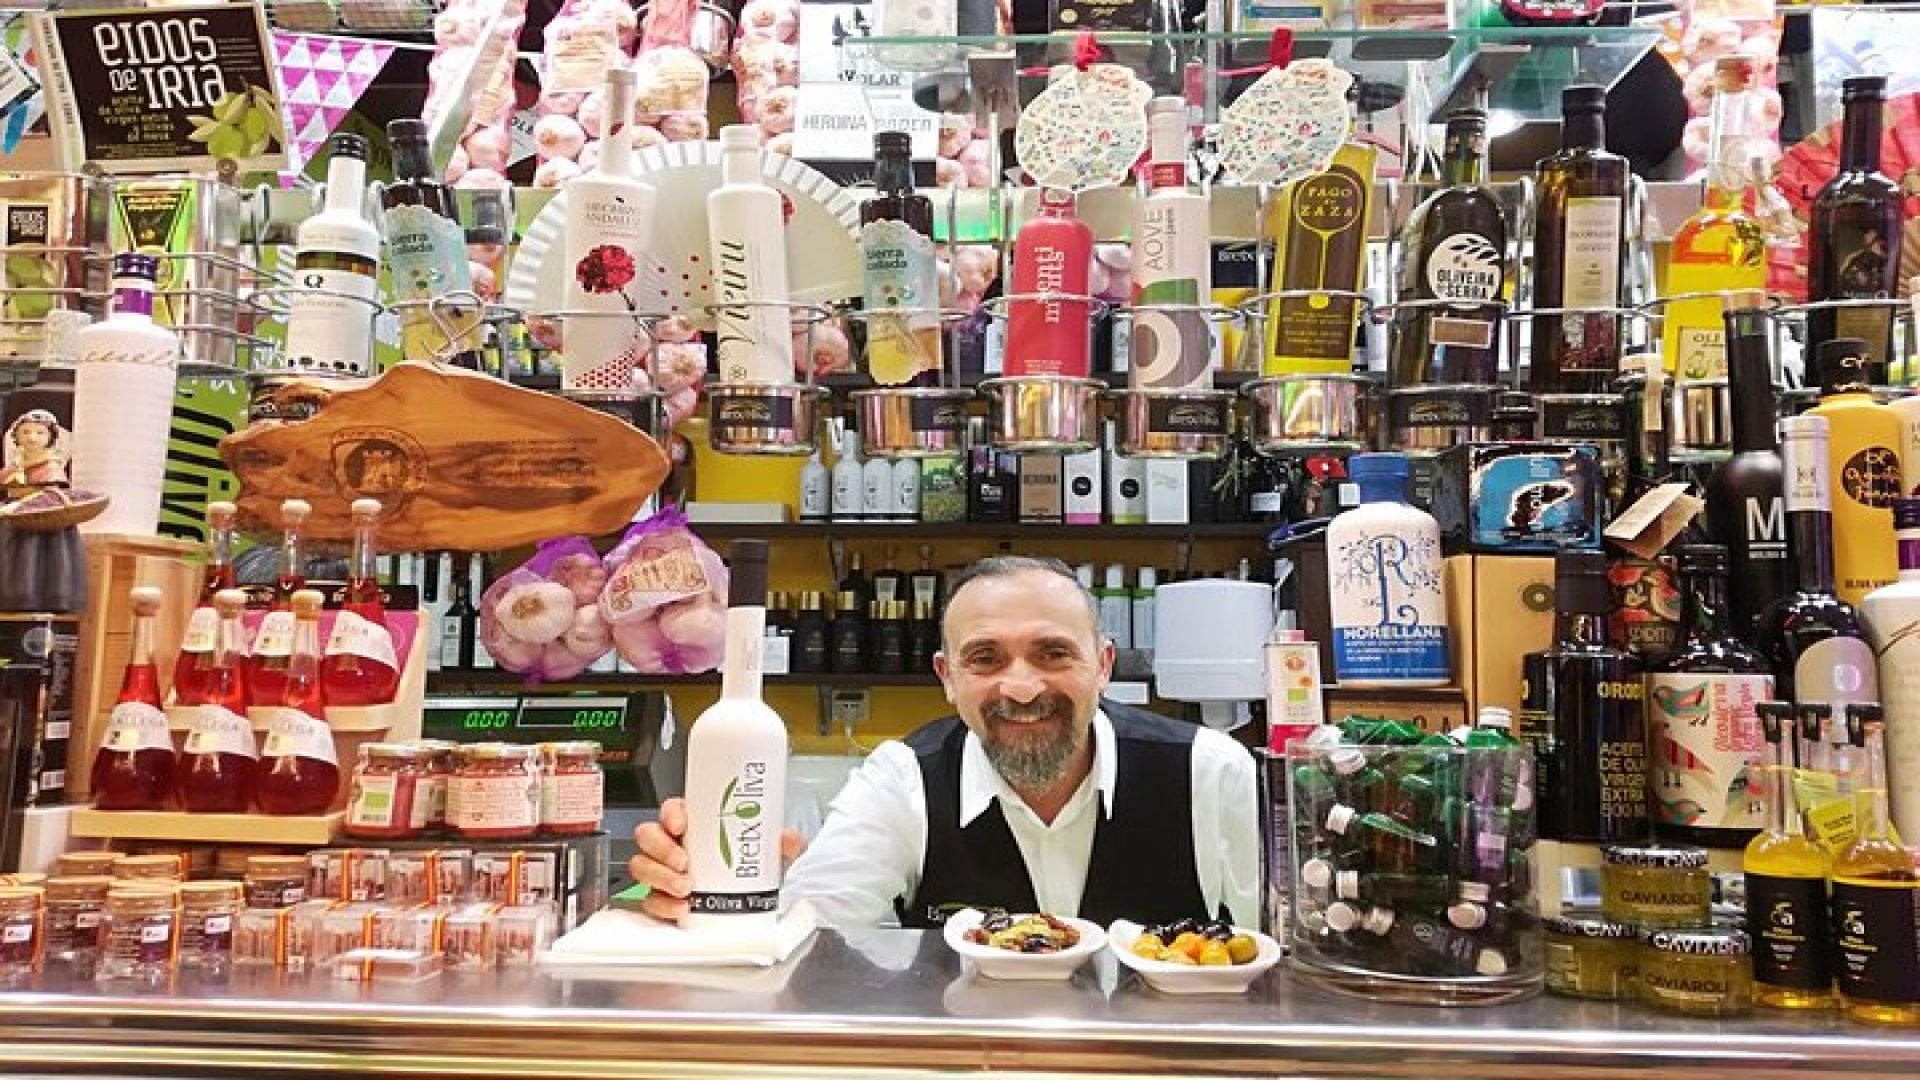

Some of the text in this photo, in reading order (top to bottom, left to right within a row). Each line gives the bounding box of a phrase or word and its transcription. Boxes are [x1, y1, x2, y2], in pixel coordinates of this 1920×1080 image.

[1143, 208, 1163, 271] AOVE
[1437, 269, 1494, 285] OLIVEIRA
[1446, 285, 1487, 298] SERRA
[1746, 496, 1785, 541] M
[463, 710, 512, 728] 0.00
[574, 710, 619, 729] 0.00
[705, 894, 743, 910] Oliva
